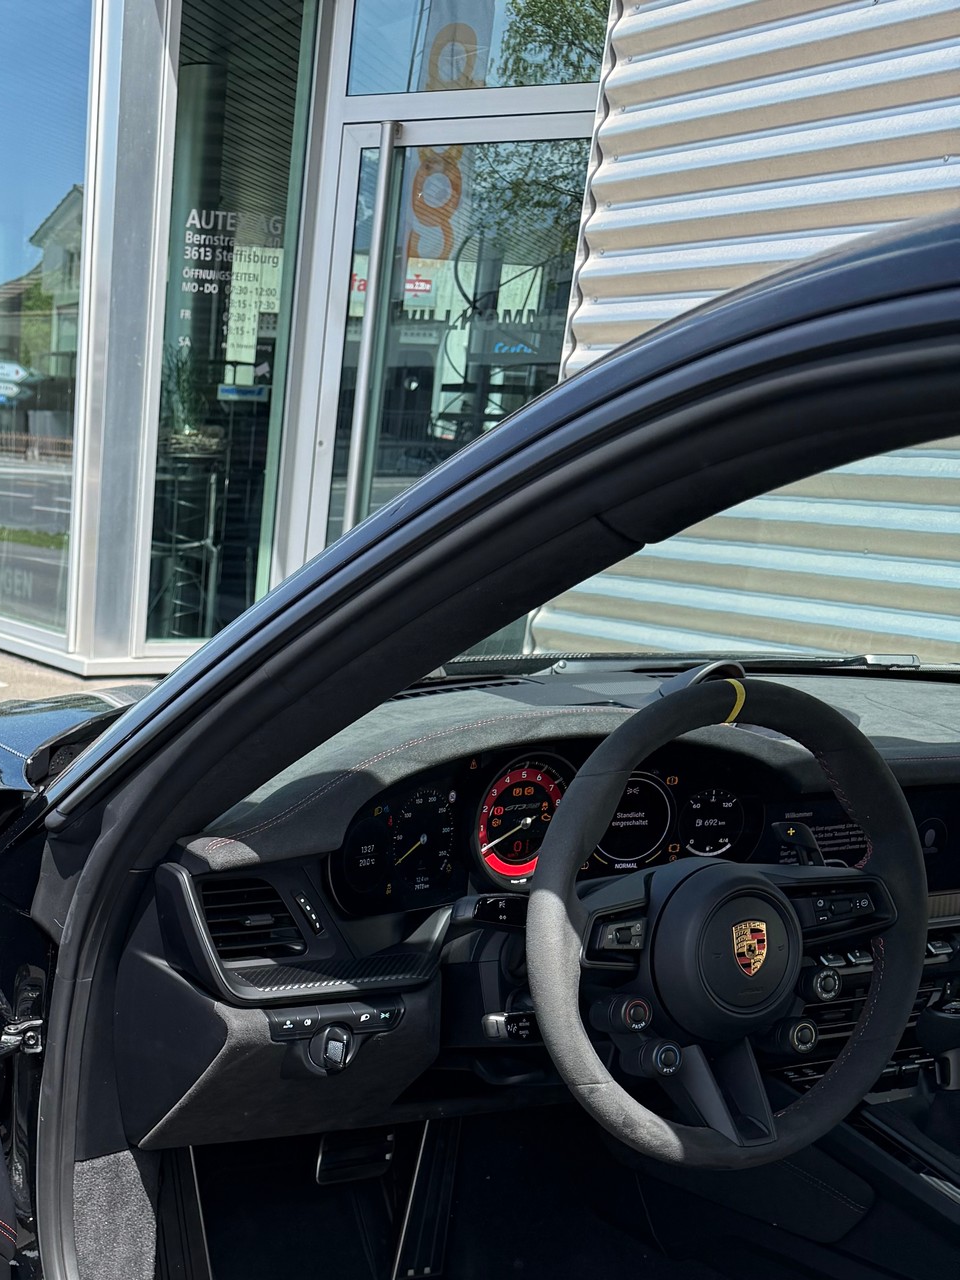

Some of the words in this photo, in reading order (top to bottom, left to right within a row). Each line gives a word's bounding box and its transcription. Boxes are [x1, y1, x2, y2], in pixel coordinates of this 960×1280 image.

[185, 208, 253, 231] AUTE
[184, 246, 212, 261] 3613
[215, 248, 280, 268] Steffisburg
[180, 309, 191, 320] FR
[178, 336, 191, 347] SA
[616, 811, 645, 819] Standlicht
[611, 819, 648, 828] eingeschaltet
[631, 1021, 646, 1029] PASM
